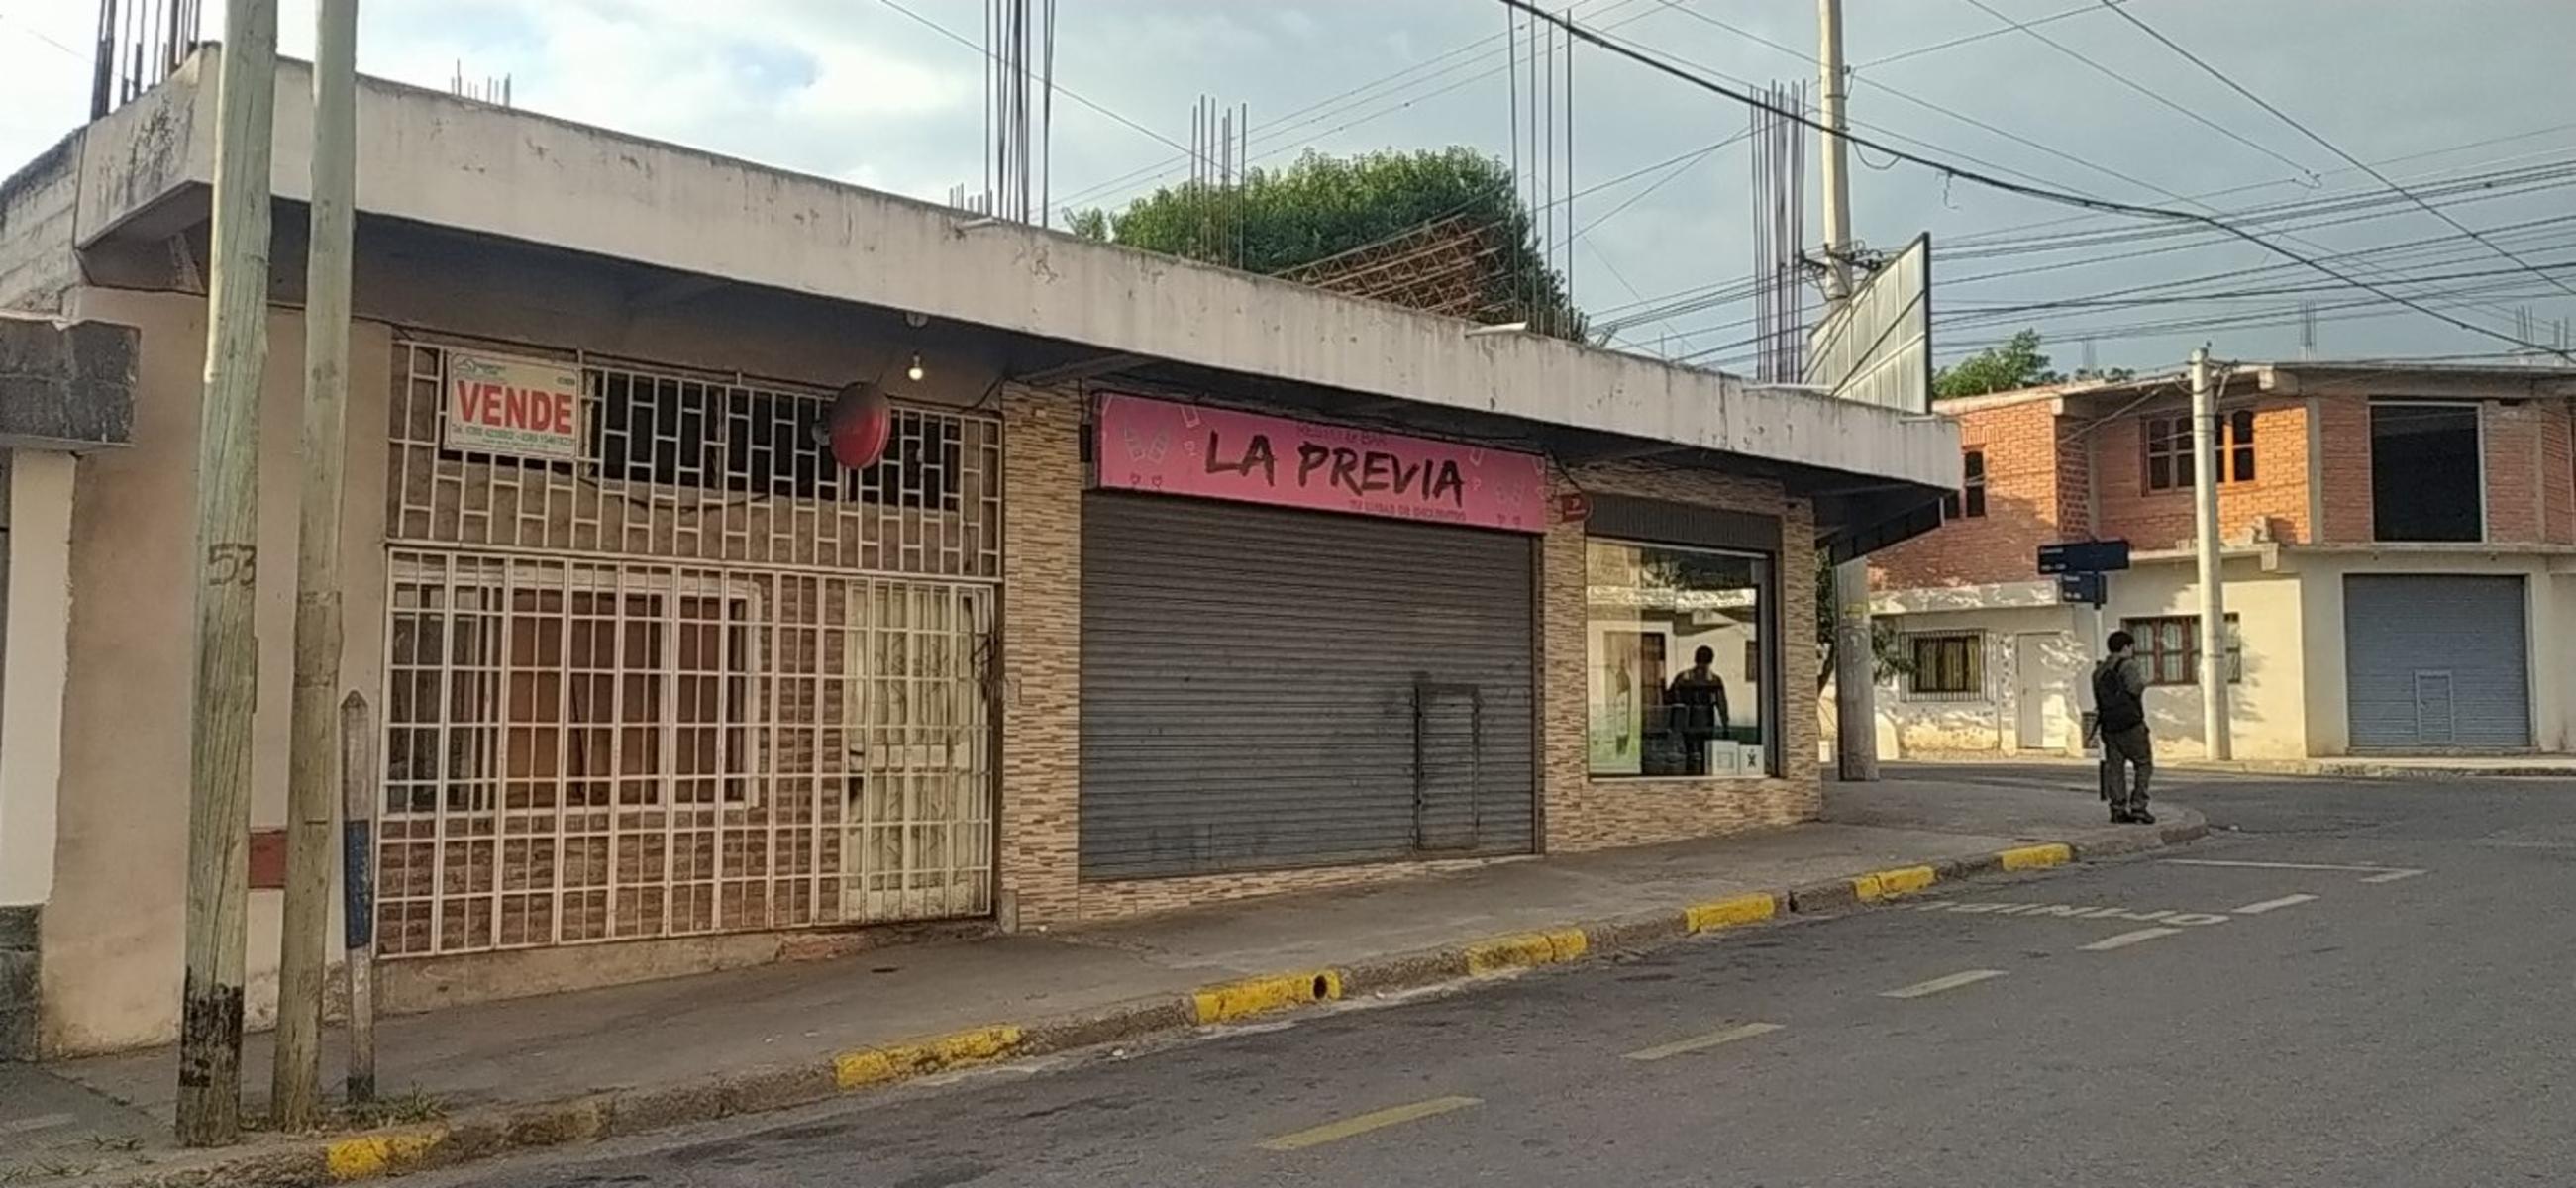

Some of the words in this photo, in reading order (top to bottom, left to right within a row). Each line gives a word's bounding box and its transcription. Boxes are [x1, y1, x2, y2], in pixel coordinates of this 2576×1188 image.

[456, 380, 572, 435] VENDE
[1205, 430, 1278, 486] LA
[1297, 441, 1464, 508] PREVIA
[209, 544, 257, 587] 53
